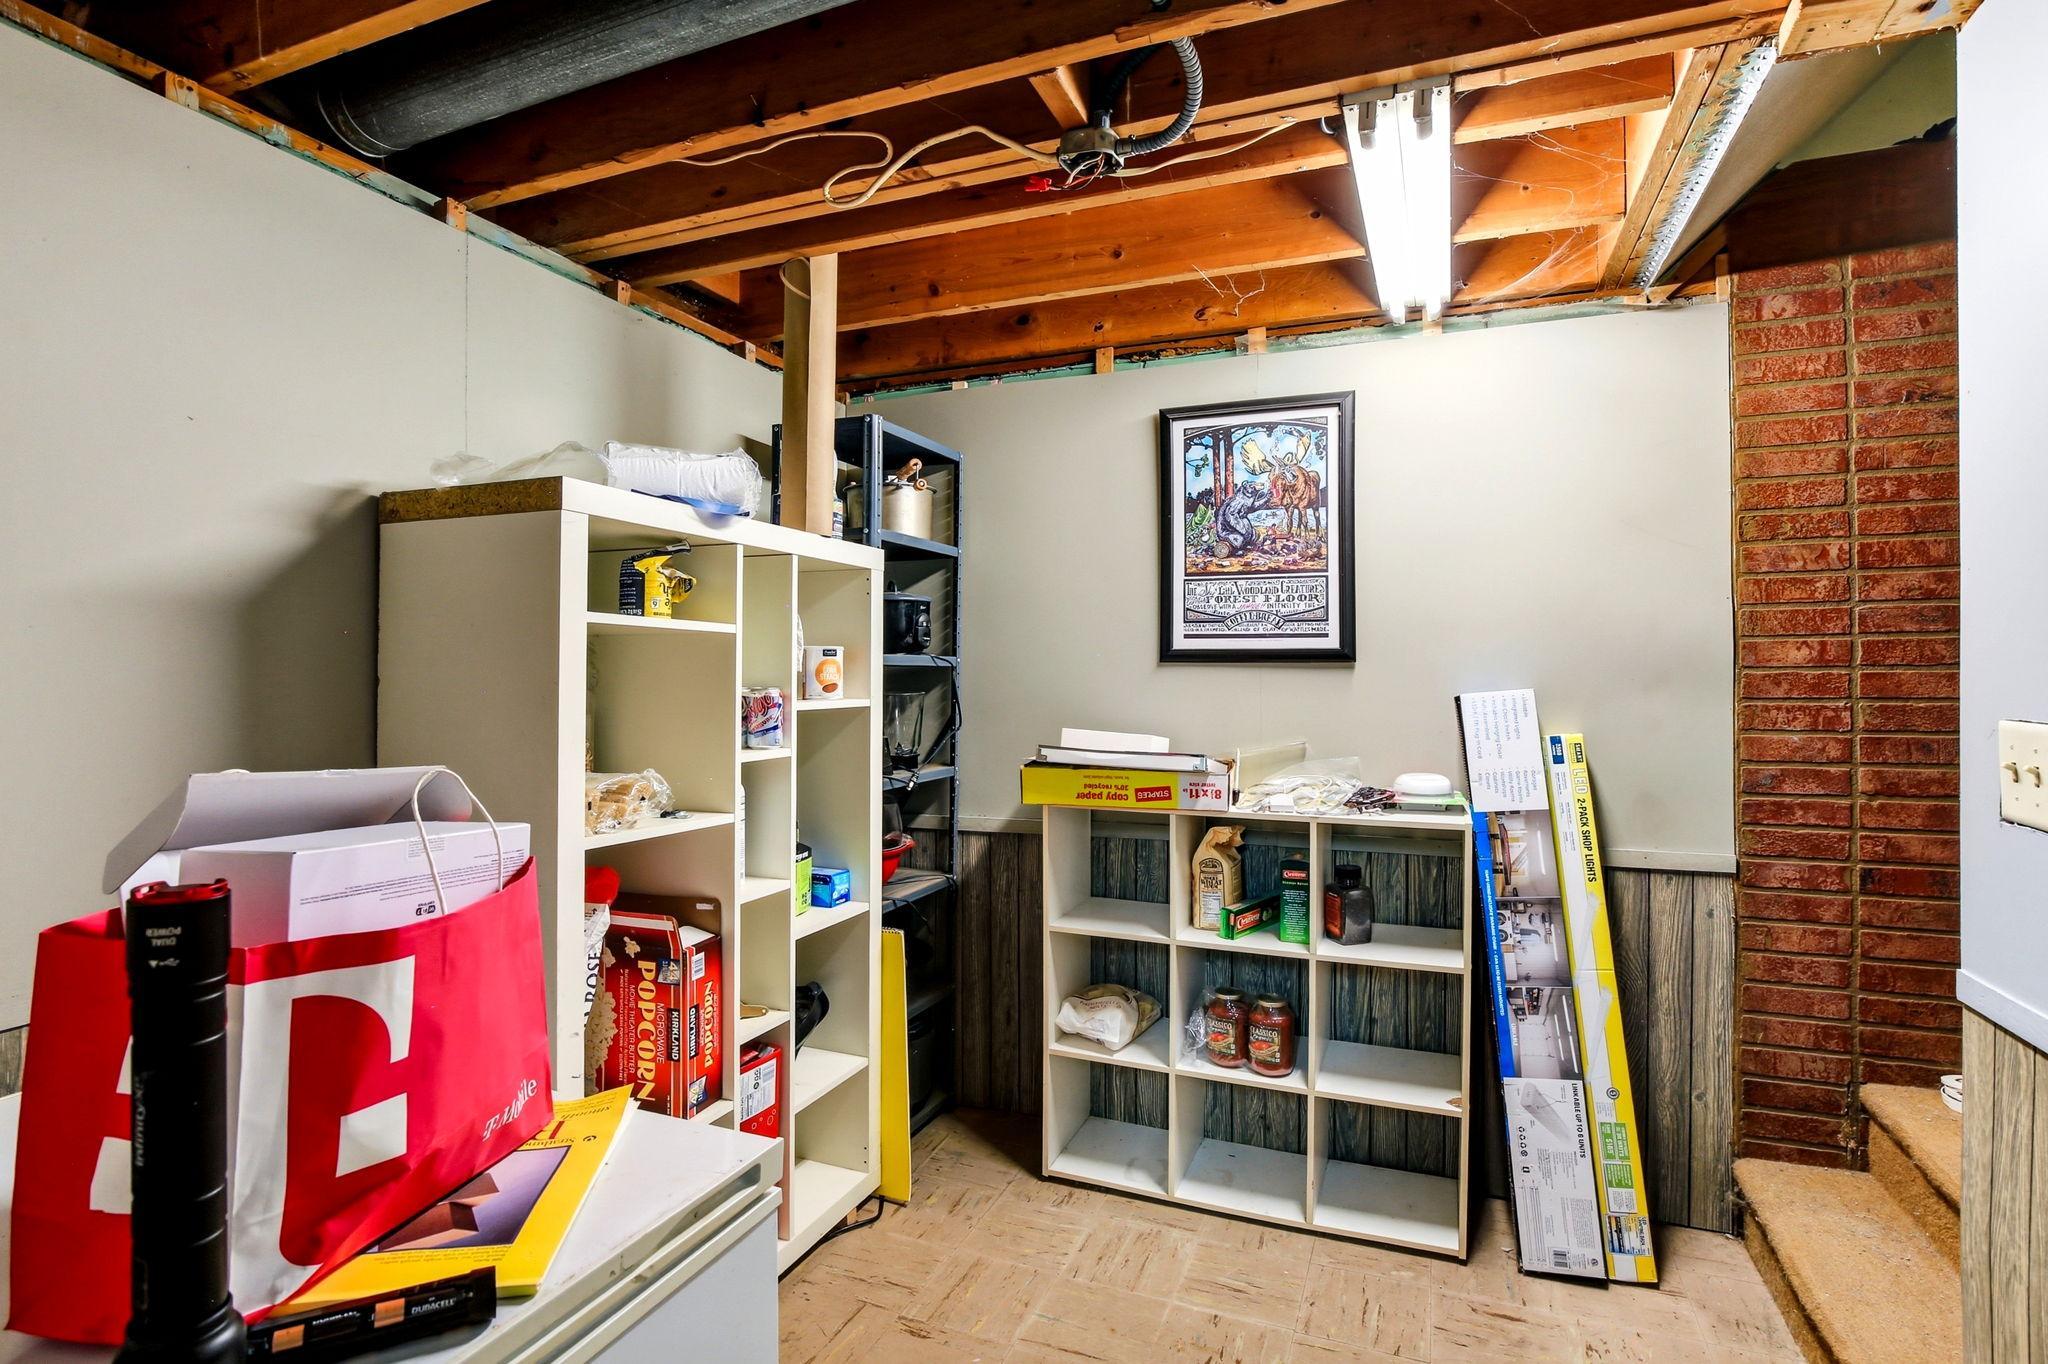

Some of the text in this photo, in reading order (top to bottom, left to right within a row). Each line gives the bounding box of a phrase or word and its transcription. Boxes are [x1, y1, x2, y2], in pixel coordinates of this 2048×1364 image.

[1206, 594, 1322, 603] FOREST FLOOR
[1573, 768, 1588, 794] LED
[1076, 791, 1129, 801] copy paper
[1137, 790, 1170, 801] STAPLES
[1577, 798, 1597, 882] 2-PACK SHOP LIGHTS
[145, 926, 182, 937] POWER
[151, 937, 176, 946] DUAL
[636, 960, 657, 1101] POPCORN
[657, 1003, 665, 1063] MICROWAVE
[704, 982, 714, 1068] POPCORN
[671, 1011, 679, 1060] KIRKLAND
[1571, 1083, 1581, 1113] LINKABLE
[1575, 1114, 1582, 1123] UP
[1576, 1124, 1583, 1132] TO
[1578, 1139, 1586, 1158] UNITS
[411, 1298, 457, 1315] DURACELL
